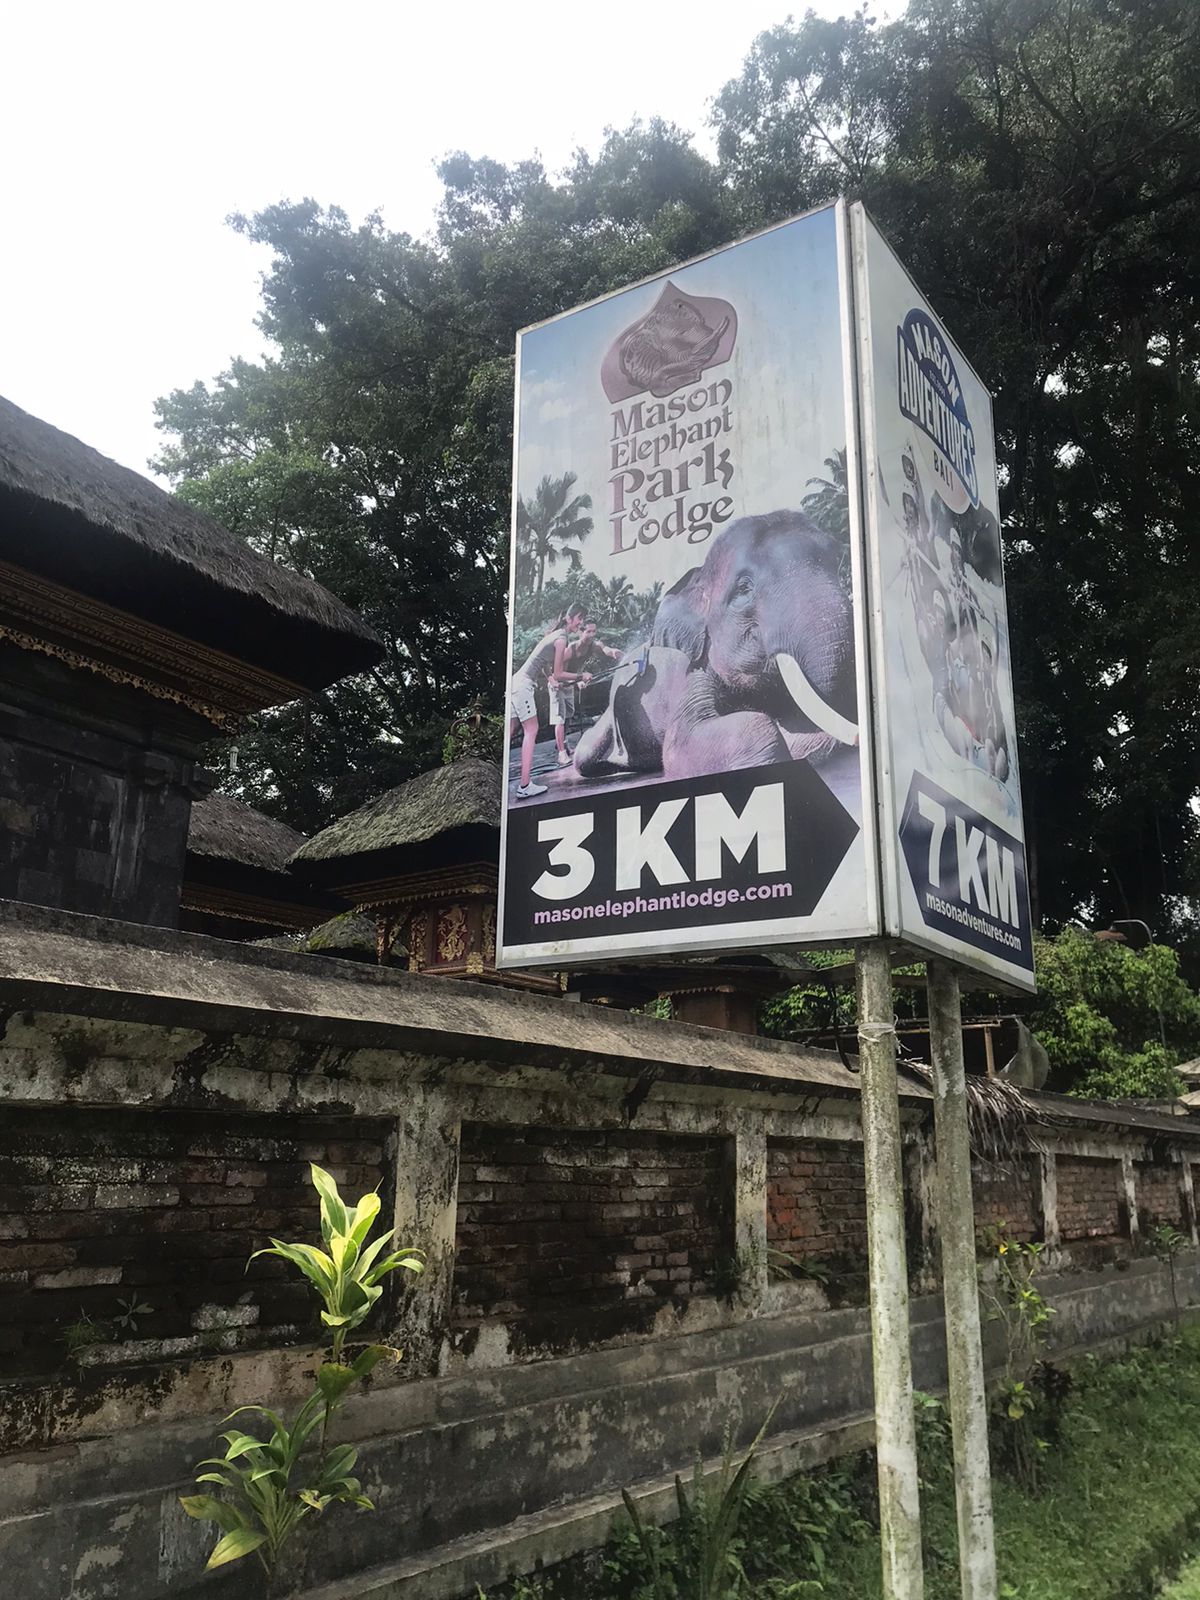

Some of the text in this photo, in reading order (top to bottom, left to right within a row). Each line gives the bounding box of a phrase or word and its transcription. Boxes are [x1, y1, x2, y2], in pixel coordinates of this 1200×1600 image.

[911, 322, 960, 407] MASON
[610, 378, 732, 442] Mason
[610, 405, 732, 470] Elephant
[900, 337, 977, 499] ADVENTURES
[607, 440, 734, 515] Park
[933, 450, 954, 491] BALI
[609, 496, 734, 556] Lodge
[629, 498, 648, 522] &
[531, 782, 787, 900] 3 KM
[918, 790, 1020, 929] 7 KM
[534, 881, 793, 924] masonelephantlodge.com
[926, 892, 1022, 951] masonadventures.com
